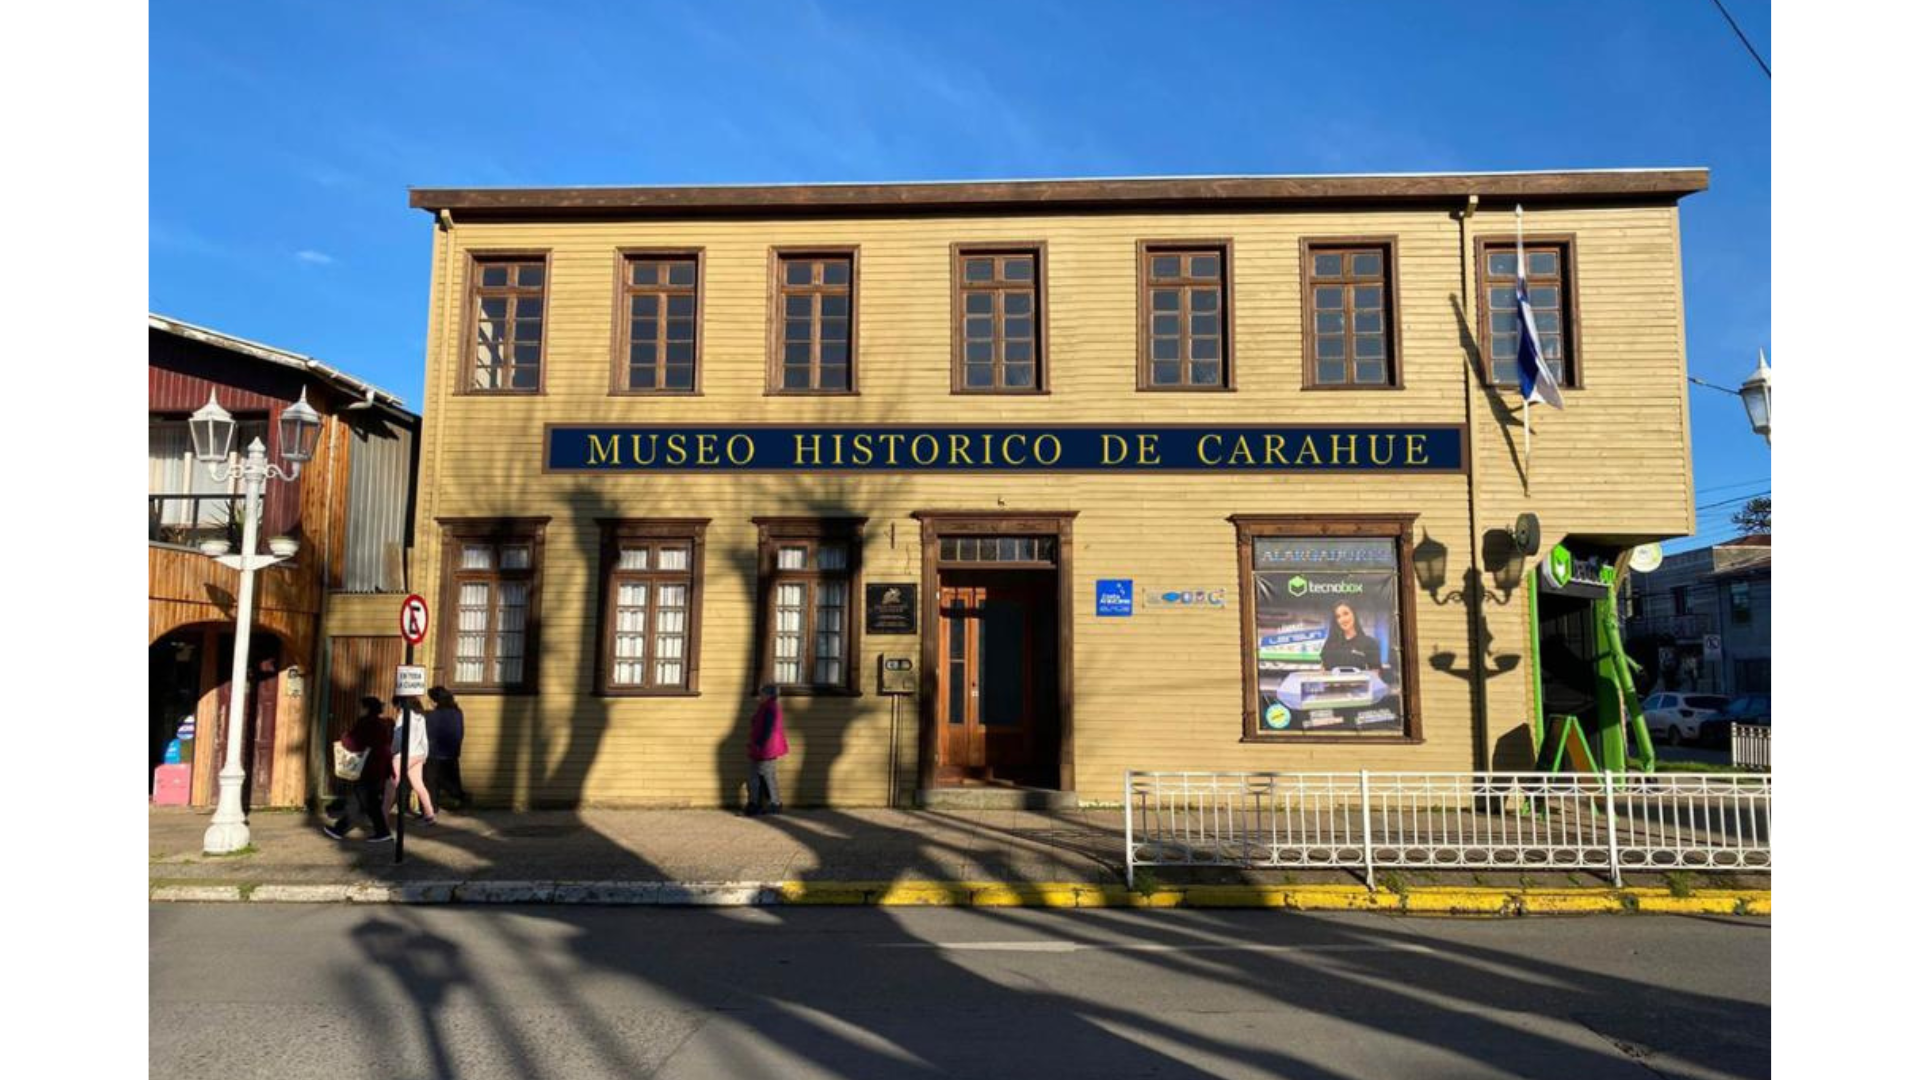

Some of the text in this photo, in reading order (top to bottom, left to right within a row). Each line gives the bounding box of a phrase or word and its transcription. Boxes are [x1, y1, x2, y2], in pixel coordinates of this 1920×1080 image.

[588, 434, 1429, 466] MUSEO HISTORICO DE CARAHUE
[1309, 581, 1363, 594] tecnobox
